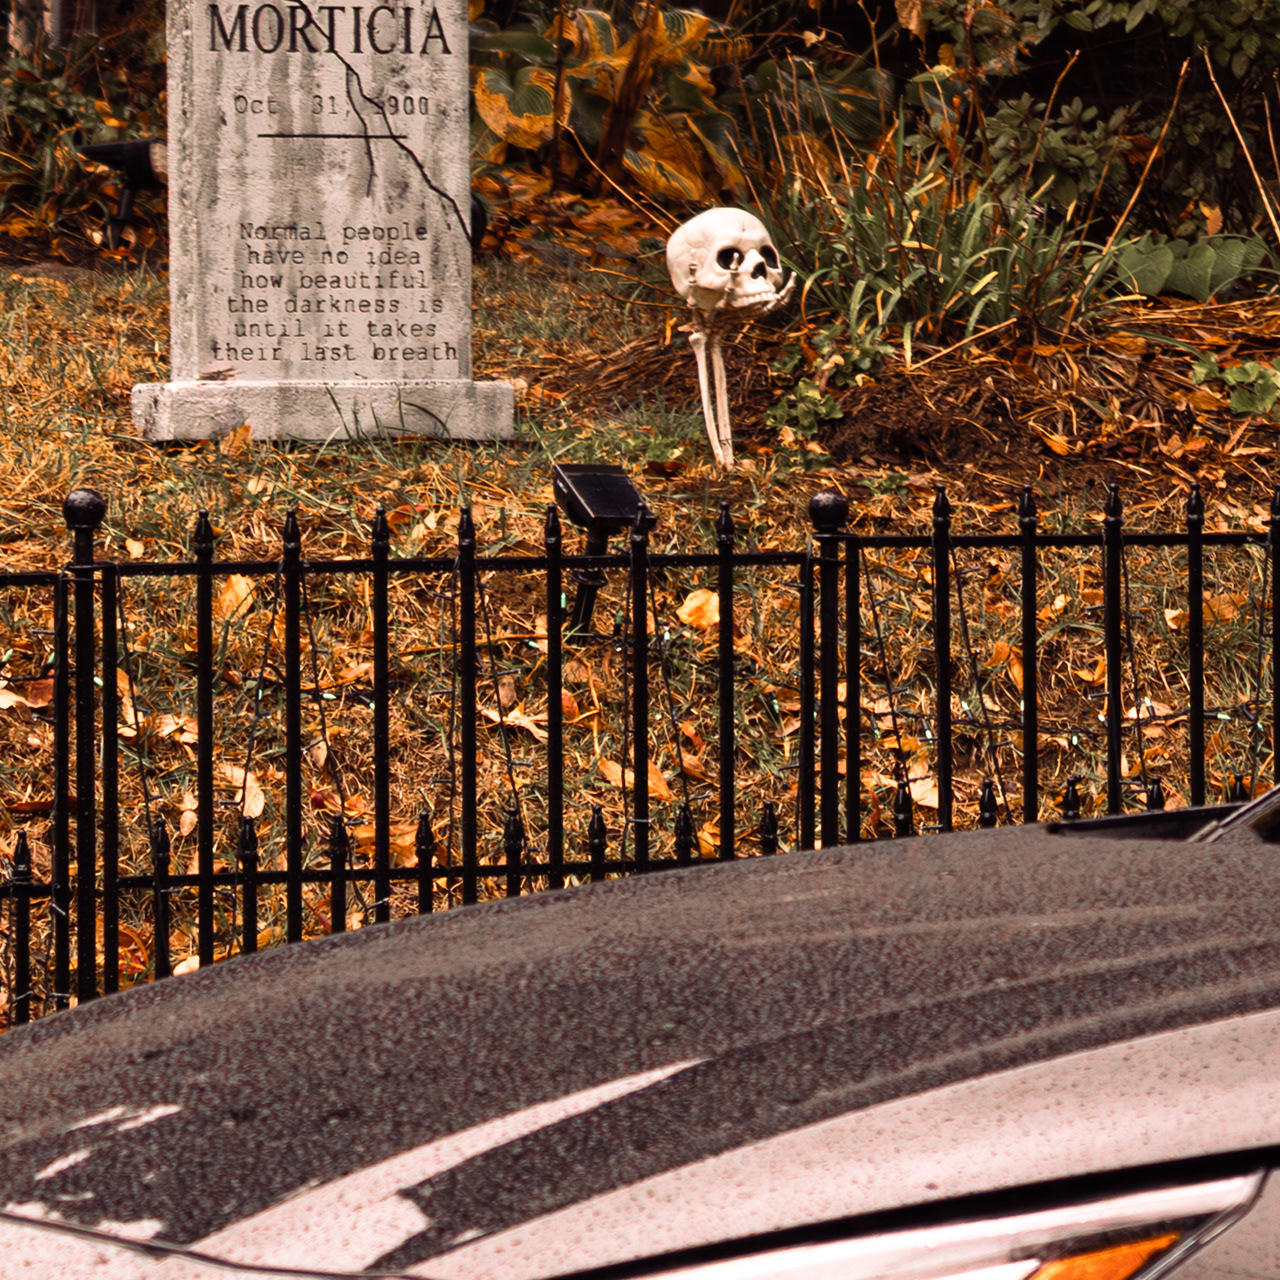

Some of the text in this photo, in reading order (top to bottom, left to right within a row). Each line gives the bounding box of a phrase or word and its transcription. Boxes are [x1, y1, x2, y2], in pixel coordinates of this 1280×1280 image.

[208, 3, 452, 54] MORTICIA
[234, 95, 278, 114] Oct
[240, 222, 428, 245] Normal people
[247, 244, 421, 264] have no idea
[240, 270, 429, 289] how beautiful
[228, 295, 443, 313] the darkness is
[234, 319, 437, 337] until it takes
[211, 341, 458, 361] their last breath
